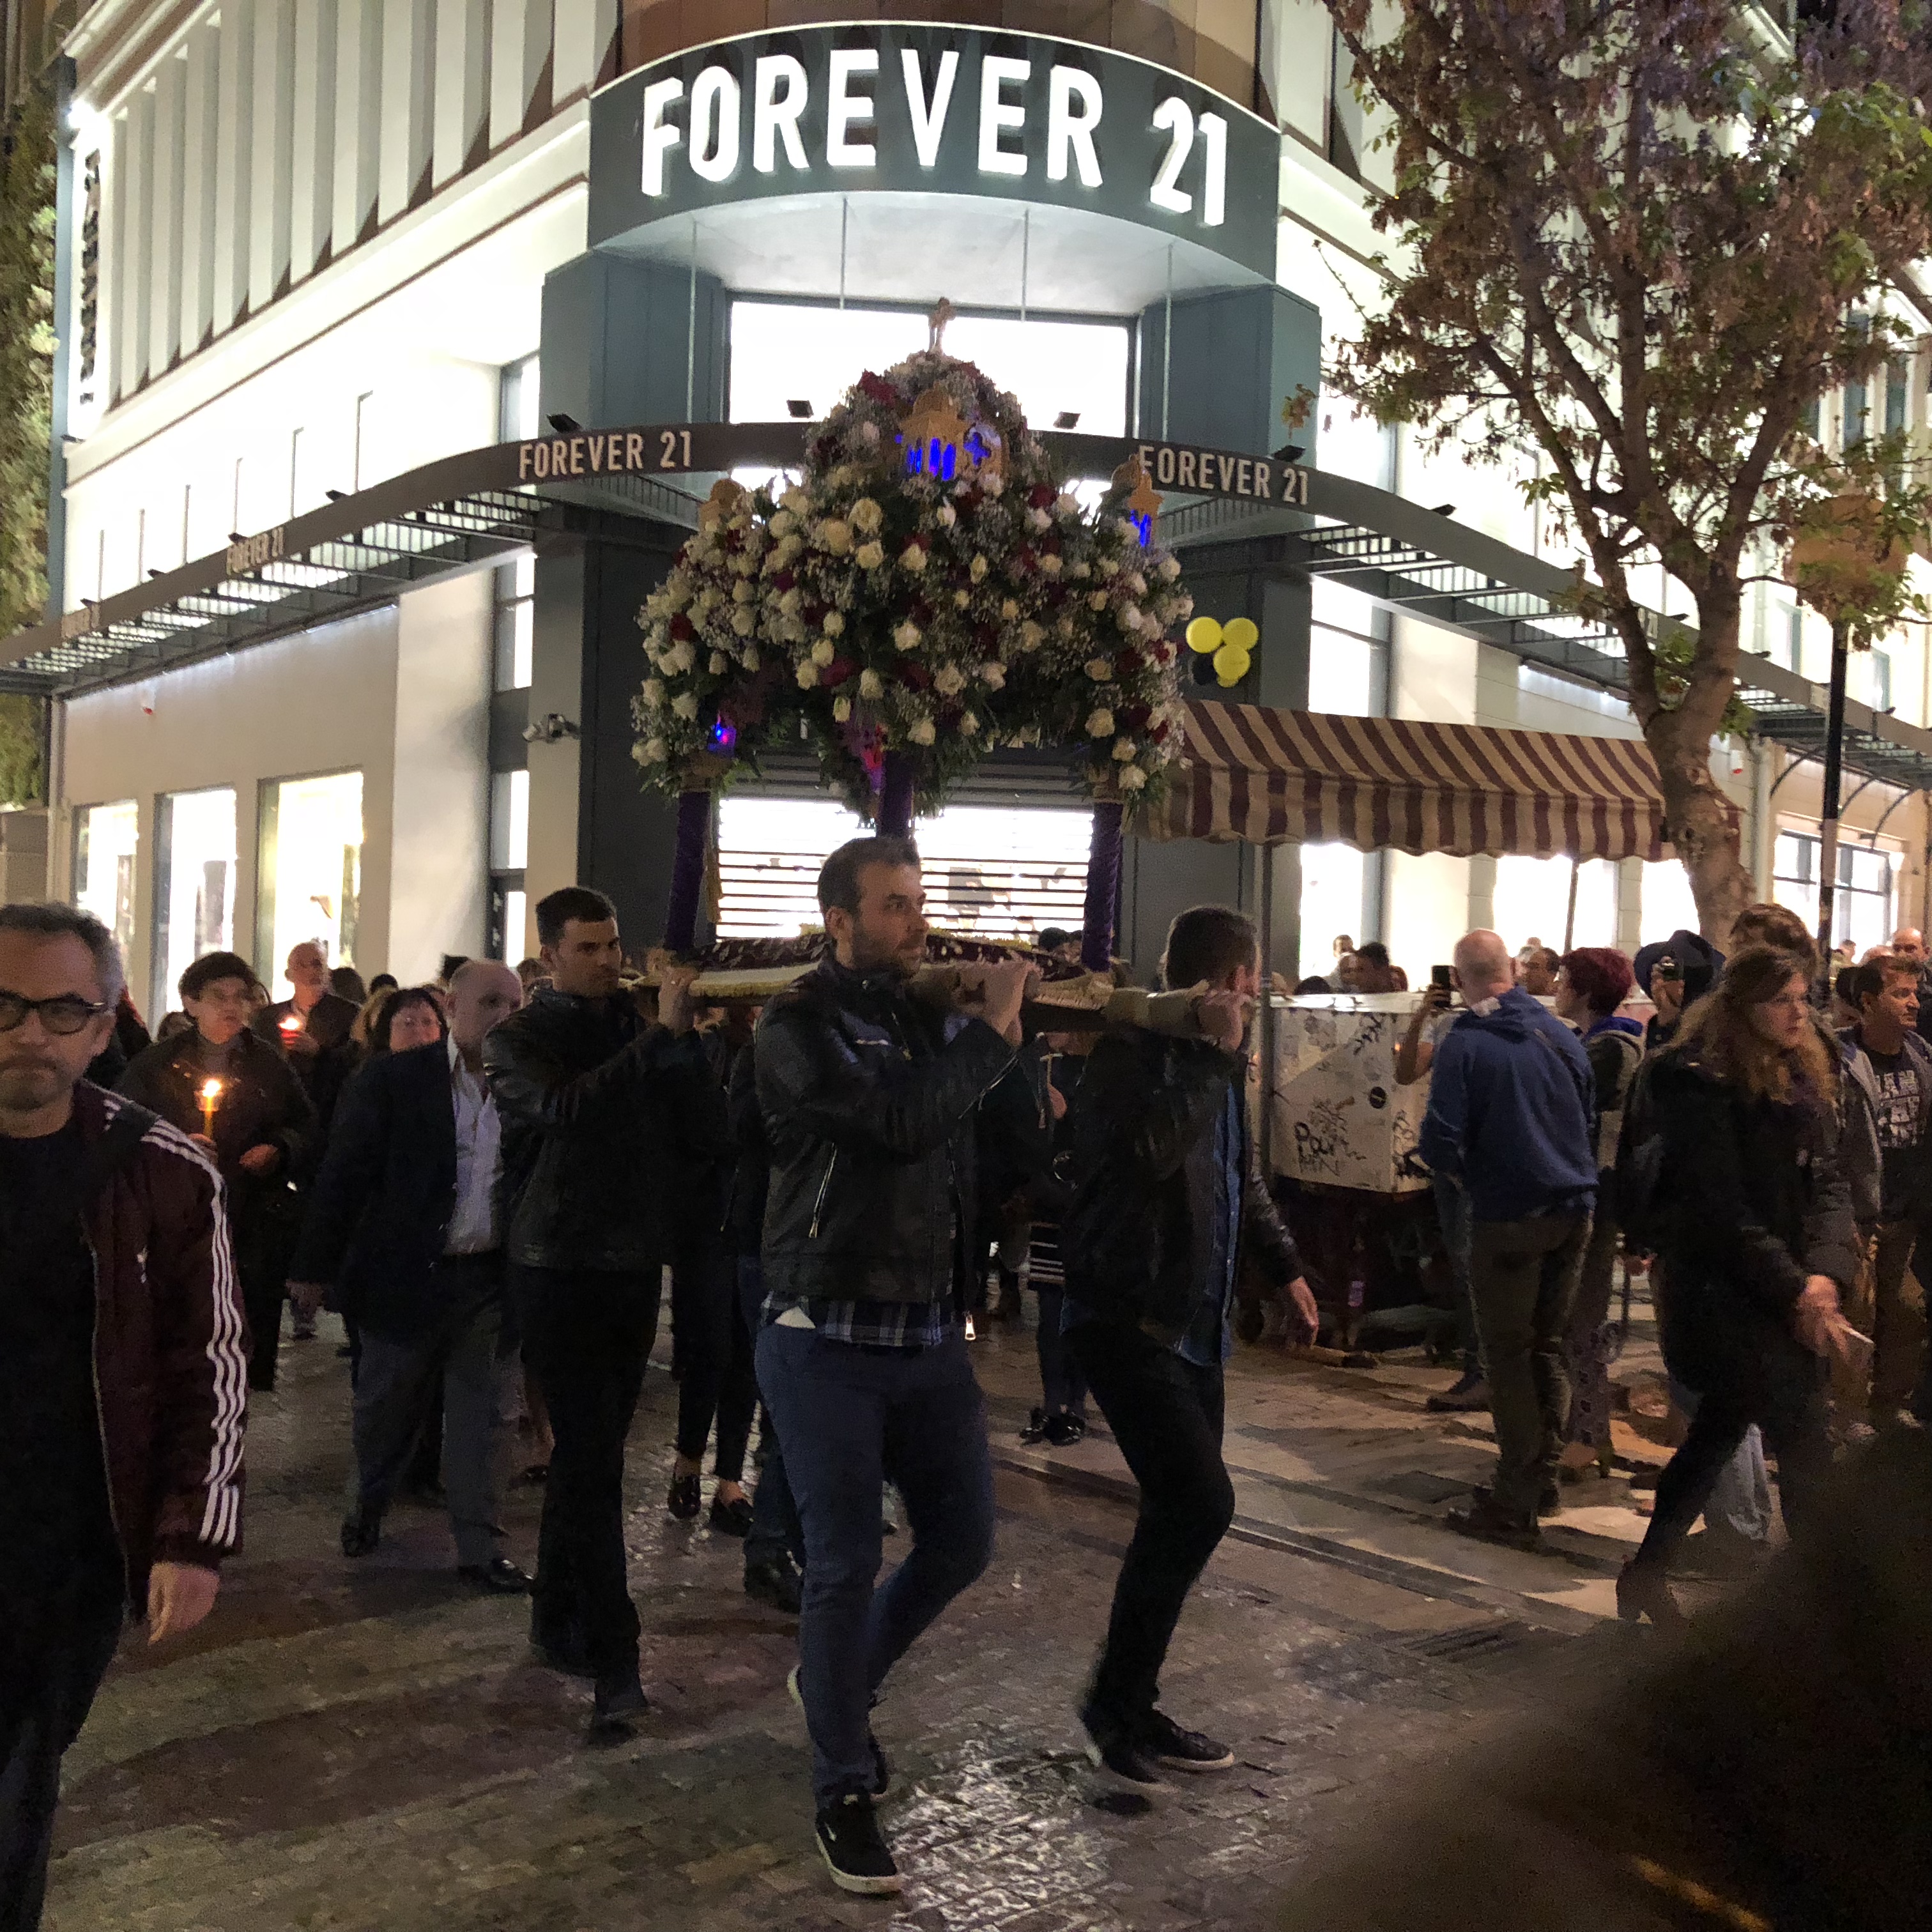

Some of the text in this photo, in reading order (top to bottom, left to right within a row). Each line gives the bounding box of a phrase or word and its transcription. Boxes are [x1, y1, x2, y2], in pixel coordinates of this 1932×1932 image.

[641, 49, 1227, 227] FOREVER 21
[519, 430, 691, 480] FOREVER 21
[1138, 445, 1308, 505] FOREVER 21
